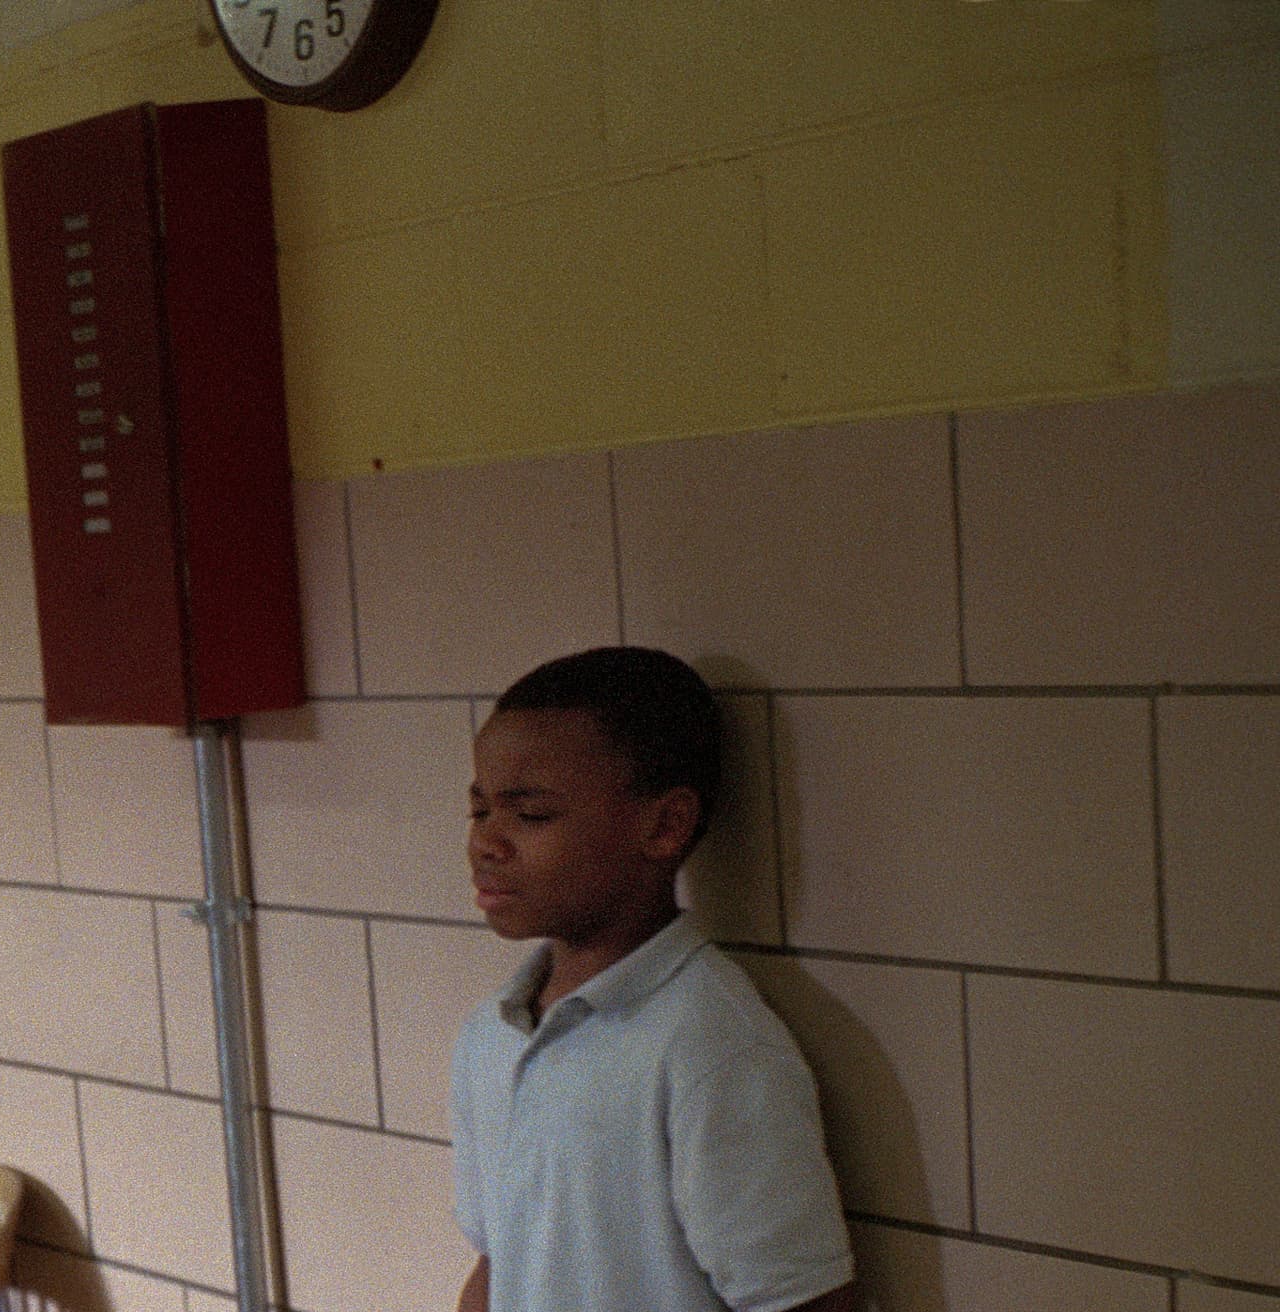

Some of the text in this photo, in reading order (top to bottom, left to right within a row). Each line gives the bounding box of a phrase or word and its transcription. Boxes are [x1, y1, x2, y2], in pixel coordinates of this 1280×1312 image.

[258, 7, 278, 48] 7
[326, 0, 345, 37] 5
[294, 19, 314, 61] 6
